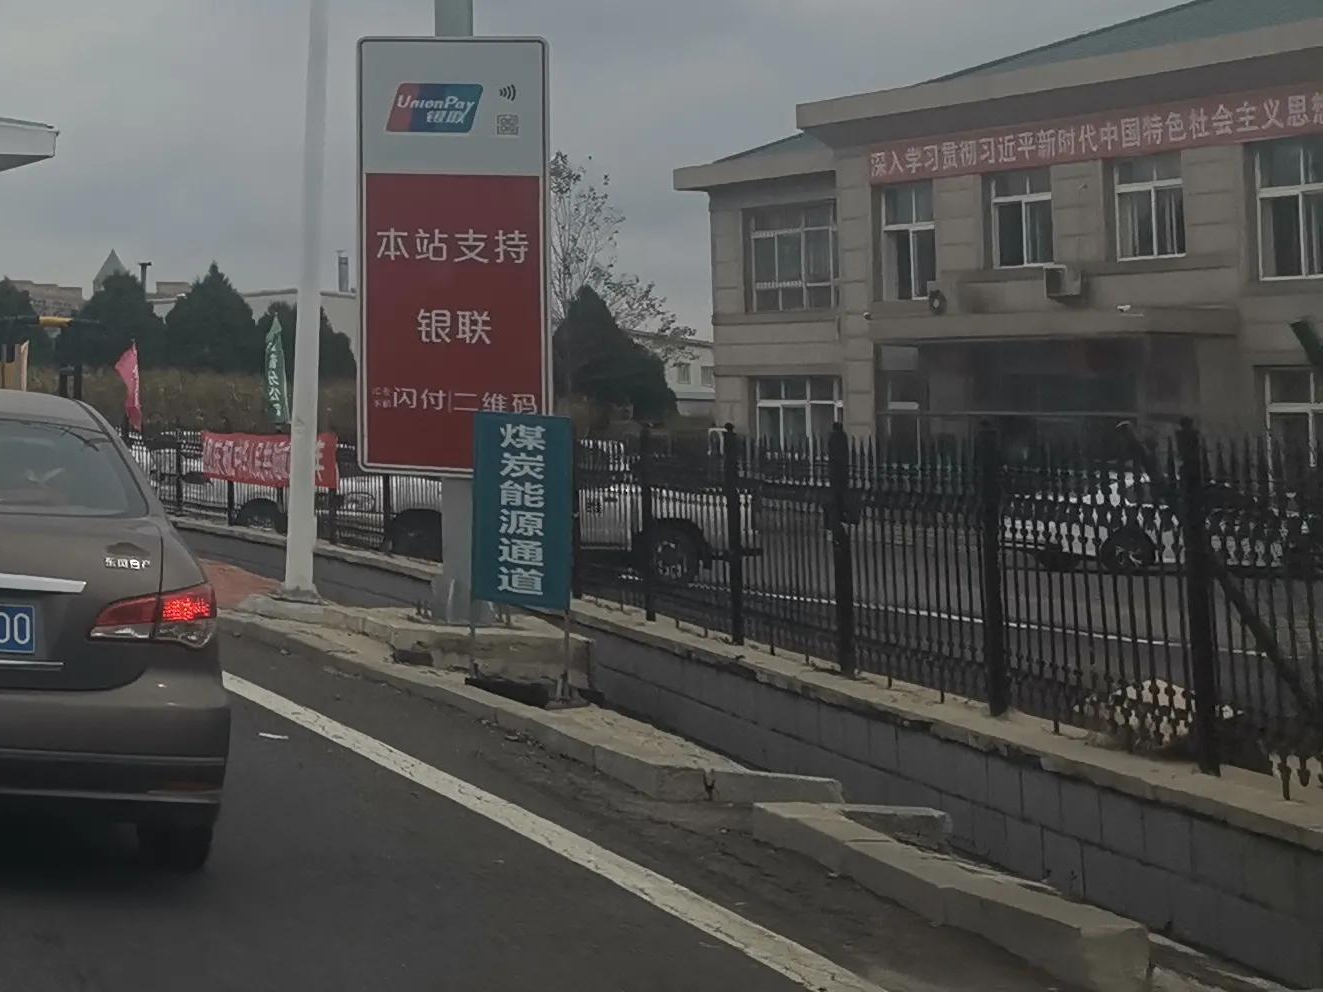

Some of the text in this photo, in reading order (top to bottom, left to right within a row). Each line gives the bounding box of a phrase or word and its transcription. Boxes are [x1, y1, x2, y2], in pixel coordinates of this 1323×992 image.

[397, 95, 475, 115] UnionPay
[426, 110, 465, 124] 银联
[376, 228, 529, 264] 本站支持
[417, 309, 492, 345] 银联
[497, 423, 546, 596] 煤炭能源通道
